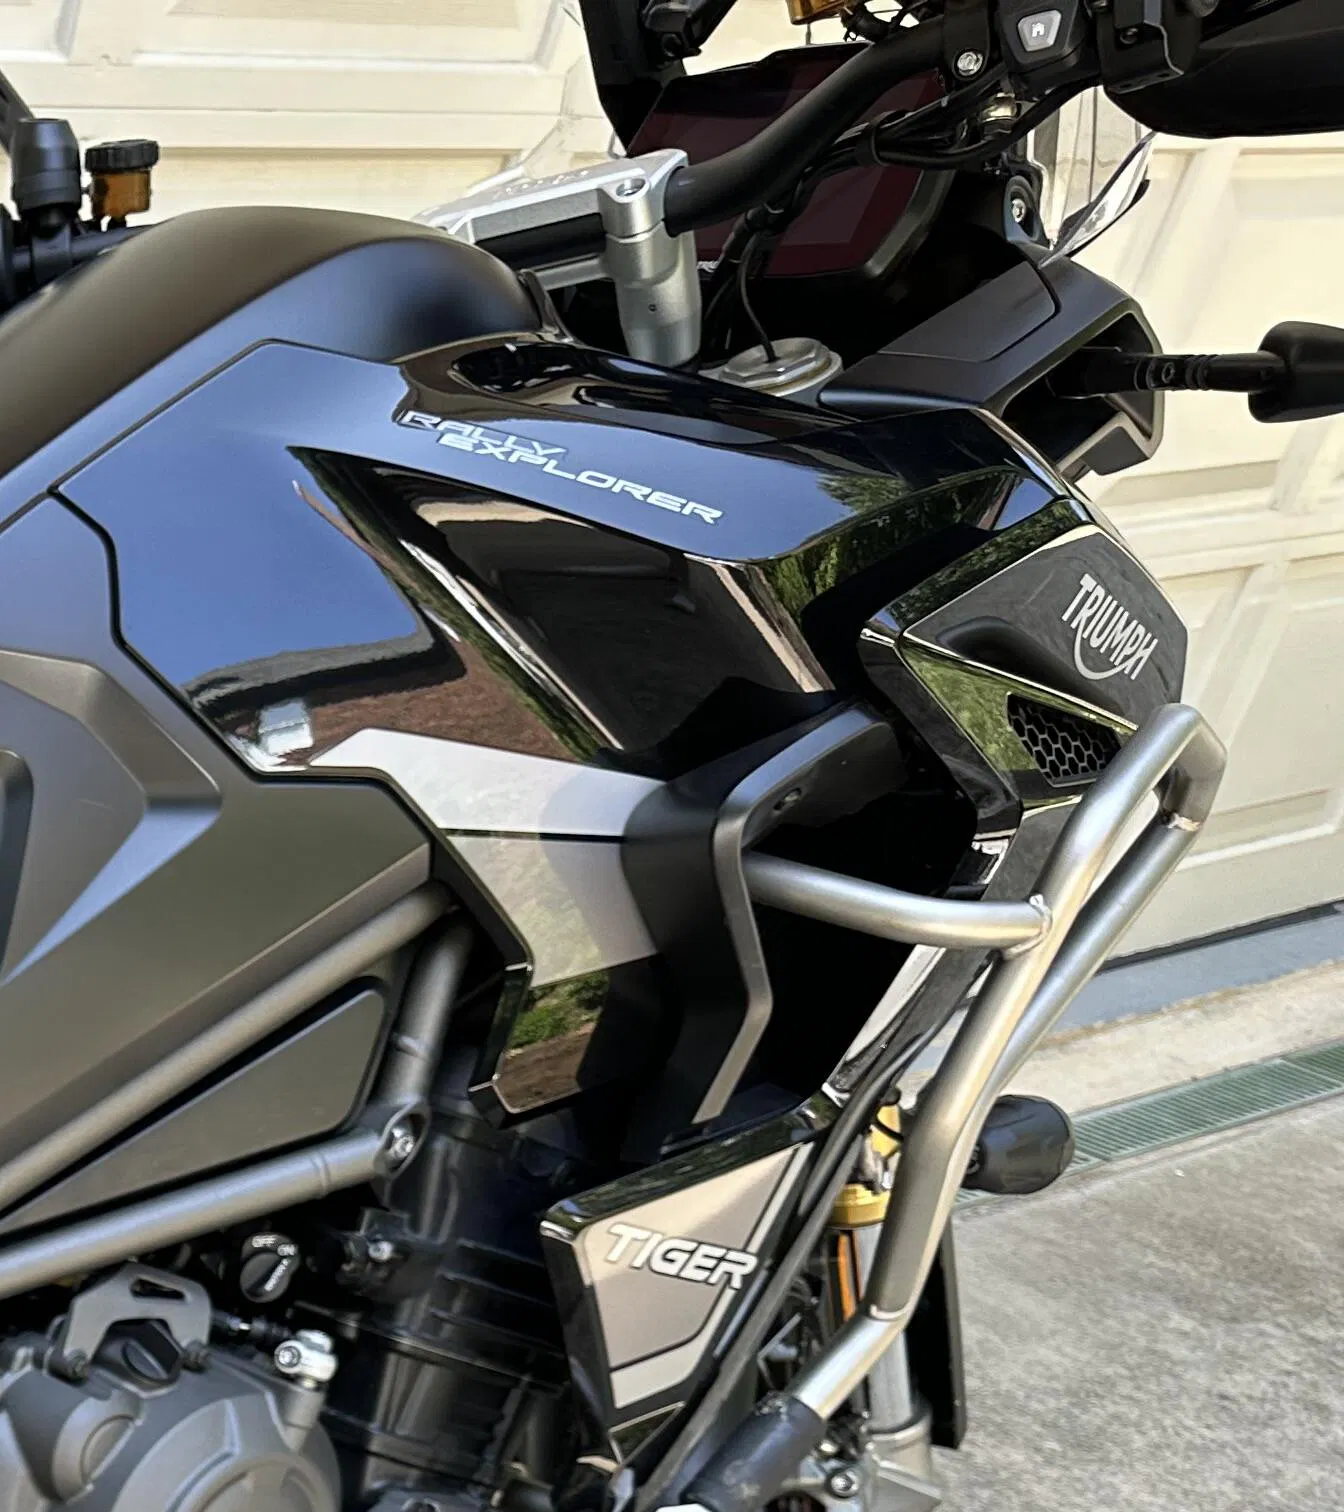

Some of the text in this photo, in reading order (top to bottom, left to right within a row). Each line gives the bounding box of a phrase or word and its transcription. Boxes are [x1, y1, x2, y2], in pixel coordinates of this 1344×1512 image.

[401, 410, 567, 456] RALLY
[438, 432, 724, 525] EXPLORER
[1062, 573, 1159, 680] TRIUMPH
[606, 1224, 759, 1289] TIGER
